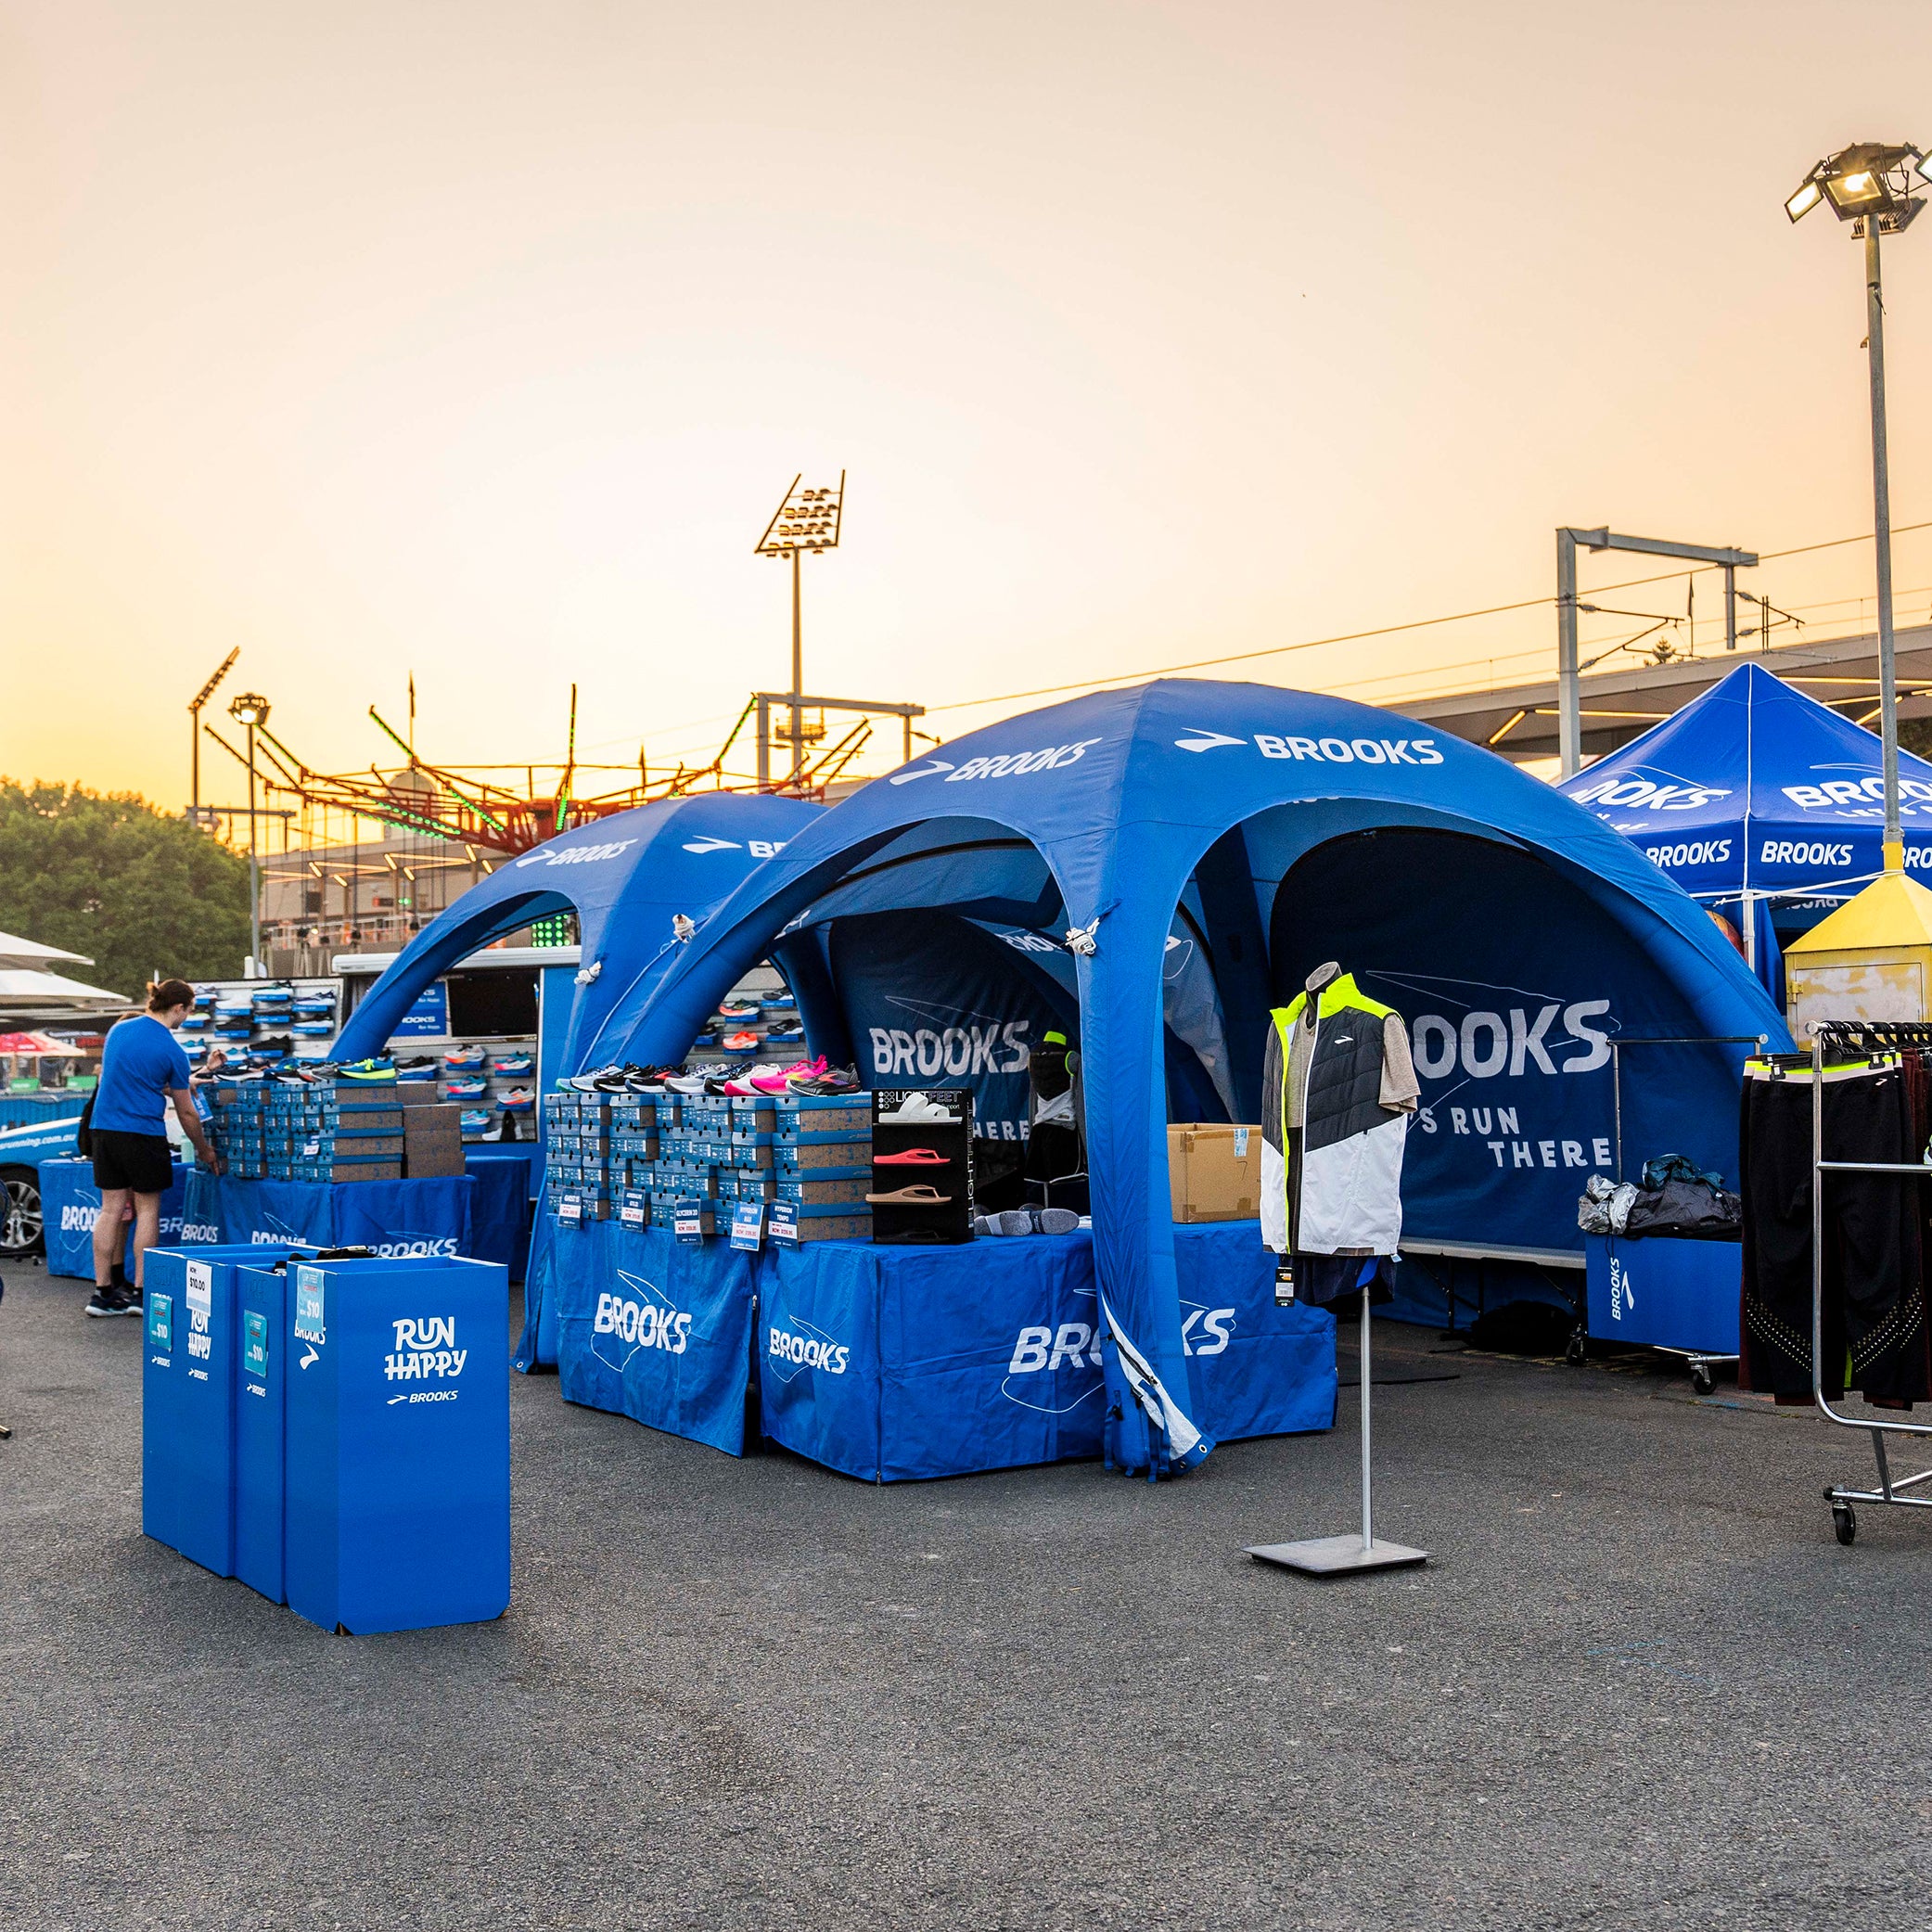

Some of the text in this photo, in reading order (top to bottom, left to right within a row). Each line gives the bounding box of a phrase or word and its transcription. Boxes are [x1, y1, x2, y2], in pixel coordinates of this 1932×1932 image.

[944, 737, 1103, 782] BROOKS
[1253, 734, 1444, 765] BROOKS
[1781, 777, 1932, 808] BROO
[546, 838, 638, 866] BROOKS
[1645, 839, 1732, 868] BROOKS
[1761, 840, 1853, 866] BROOKS
[869, 1020, 1030, 1077] BROOKS
[1414, 999, 1612, 1079] OOKS
[973, 1120, 1030, 1142] HERE
[1453, 1107, 1520, 1134] RUN
[1488, 1138, 1612, 1170] THERE
[60, 1206, 101, 1233] BROO
[189, 1277, 206, 1291] $10.00
[1611, 1258, 1621, 1321] BROOKS
[307, 1299, 320, 1319] $10
[594, 1293, 692, 1355] BROOKS
[157, 1323, 168, 1338] $10
[392, 1316, 454, 1351] RUN
[1008, 1308, 1235, 1374] BRKS
[187, 1332, 212, 1361] HAPPY
[252, 1343, 263, 1362] $10
[769, 1328, 850, 1375] BROOKS
[384, 1350, 467, 1381] HAPPY
[409, 1389, 459, 1403] BROOKS
